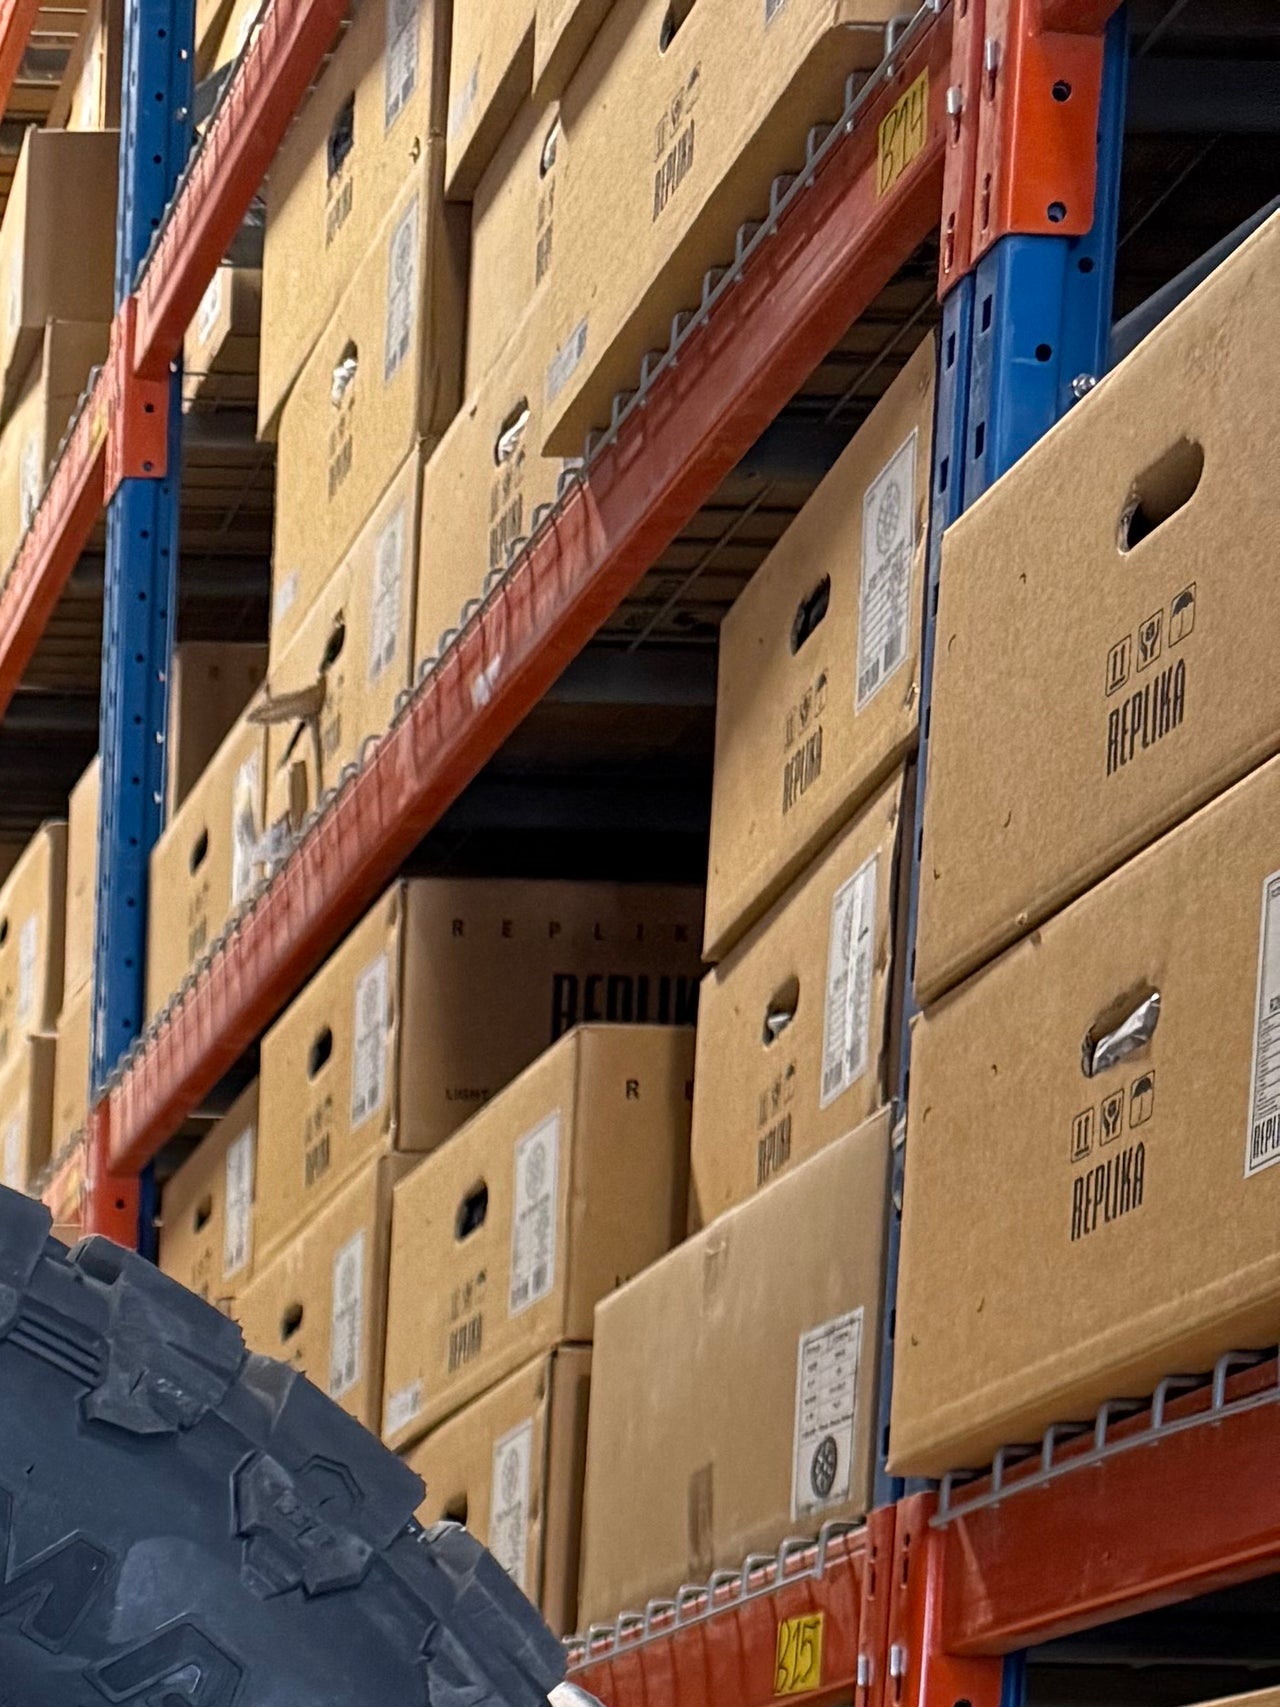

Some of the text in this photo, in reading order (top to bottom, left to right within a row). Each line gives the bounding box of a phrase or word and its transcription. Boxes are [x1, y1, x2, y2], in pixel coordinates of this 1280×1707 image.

[653, 118, 695, 223] REPLIKA
[882, 86, 925, 186] B14
[1105, 656, 1187, 777] REPLIKA
[782, 725, 824, 816] REPLIKA
[757, 1113, 792, 1188] REPLIKA
[1070, 1141, 1145, 1243] REPLIKA
[776, 1617, 820, 1694] B15
